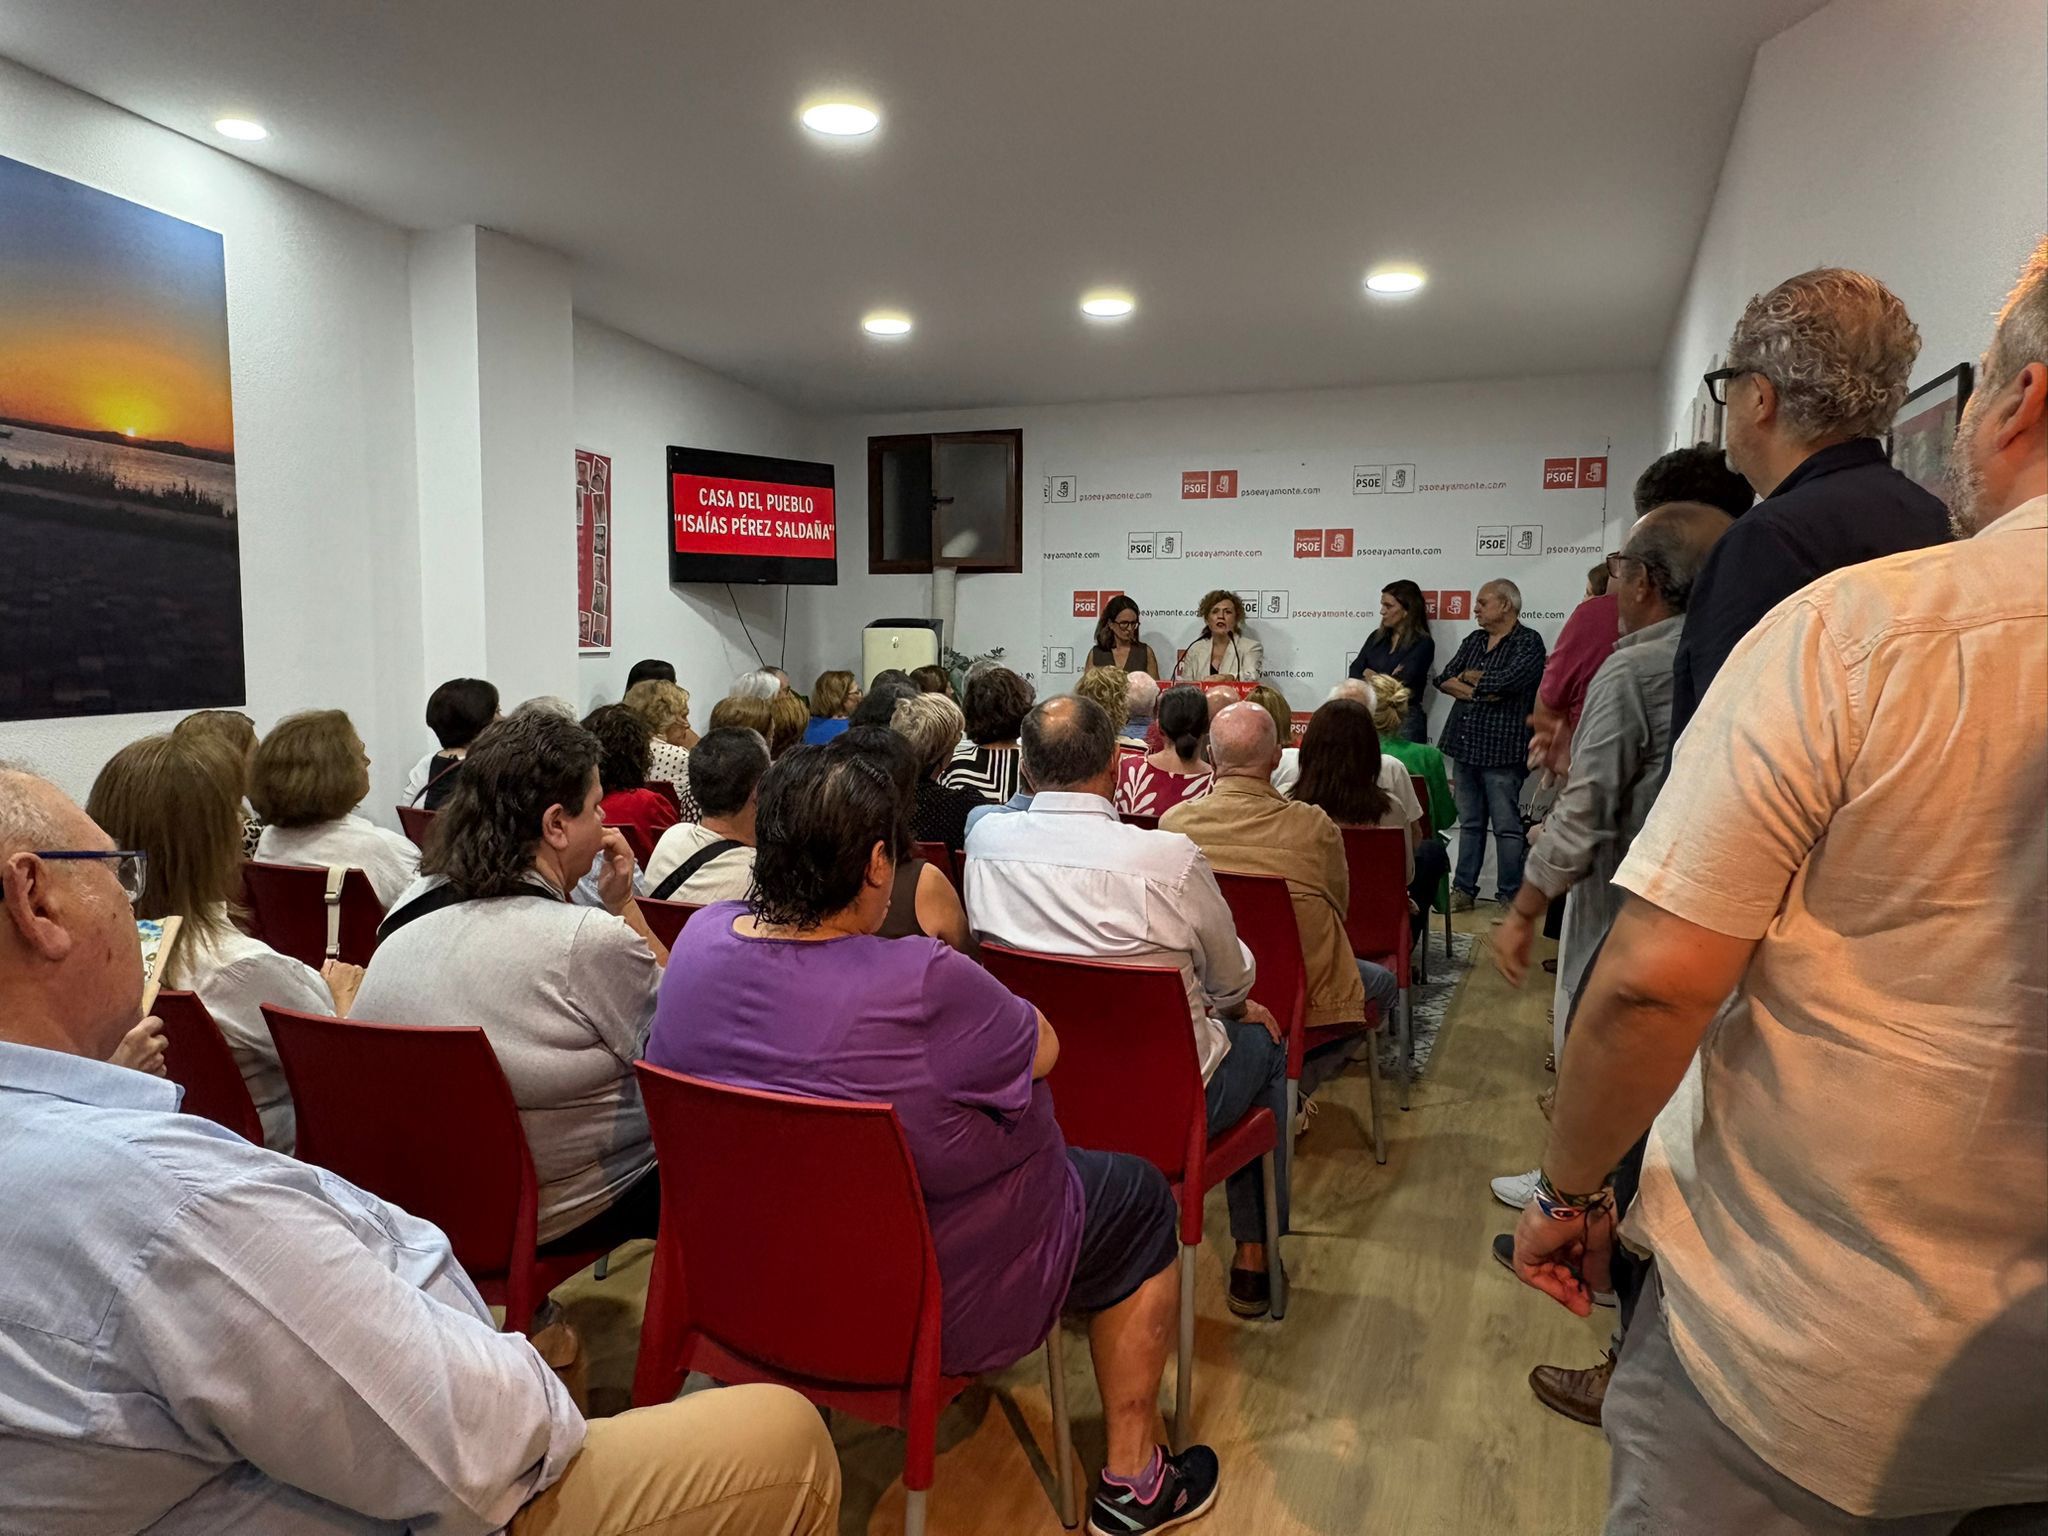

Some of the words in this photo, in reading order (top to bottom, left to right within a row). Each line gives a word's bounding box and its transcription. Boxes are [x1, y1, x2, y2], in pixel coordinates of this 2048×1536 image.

[1546, 472, 1573, 483] PSOE
[1184, 484, 1206, 494] PSOE
[1356, 478, 1380, 489] PSOE
[1419, 481, 1507, 492] psoeayamonte.com
[1079, 492, 1152, 502] psoeayamonte.com
[1241, 487, 1321, 498] psoeayamonte.com
[699, 487, 735, 508] CASA
[738, 491, 763, 512] DEL
[766, 494, 814, 514] PUEBLO
[674, 511, 728, 534] "ISAÍAS
[731, 514, 772, 537] PÉREZ
[775, 519, 835, 541] SALDAÑA"
[1130, 544, 1152, 554] PSOE
[1296, 541, 1321, 552] PSOE
[1479, 539, 1506, 551] PSOE
[1546, 545, 1603, 555] psoeayamo
[1185, 549, 1262, 560] psoeayamonte.com
[1356, 547, 1441, 557] psoeayamonte.com
[1074, 602, 1096, 613] PSOE
[1292, 609, 1374, 619] psoeayamonte.com
[1519, 610, 1565, 619] onte.com
[1257, 668, 1314, 679] yamonte.com
[1290, 723, 1308, 734] PSO
